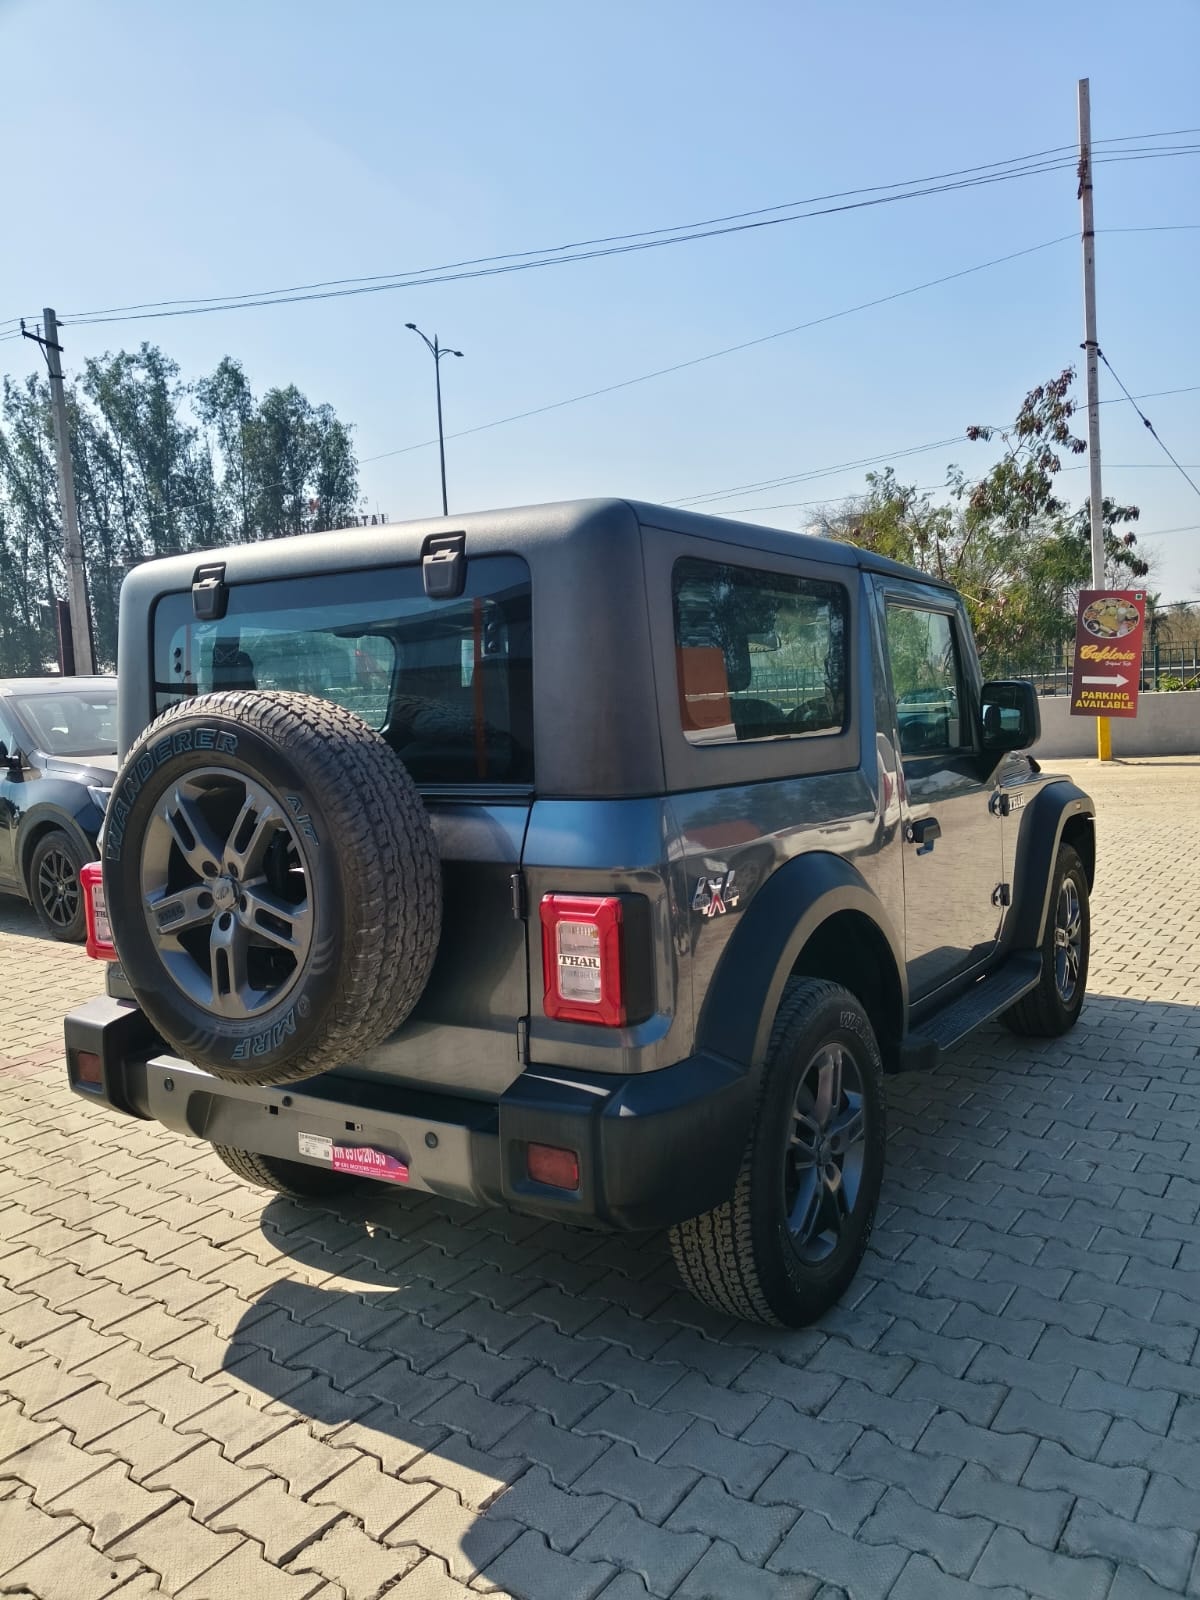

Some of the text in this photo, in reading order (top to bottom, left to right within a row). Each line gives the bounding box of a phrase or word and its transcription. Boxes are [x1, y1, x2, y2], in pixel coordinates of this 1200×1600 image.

[1080, 645, 1136, 662] Cafeteria
[1081, 691, 1130, 701] PARKING
[1075, 700, 1135, 710] AVAILABLE
[105, 727, 239, 862] WANDERER
[559, 955, 600, 969] THAR
[231, 1007, 298, 1060] MRF
